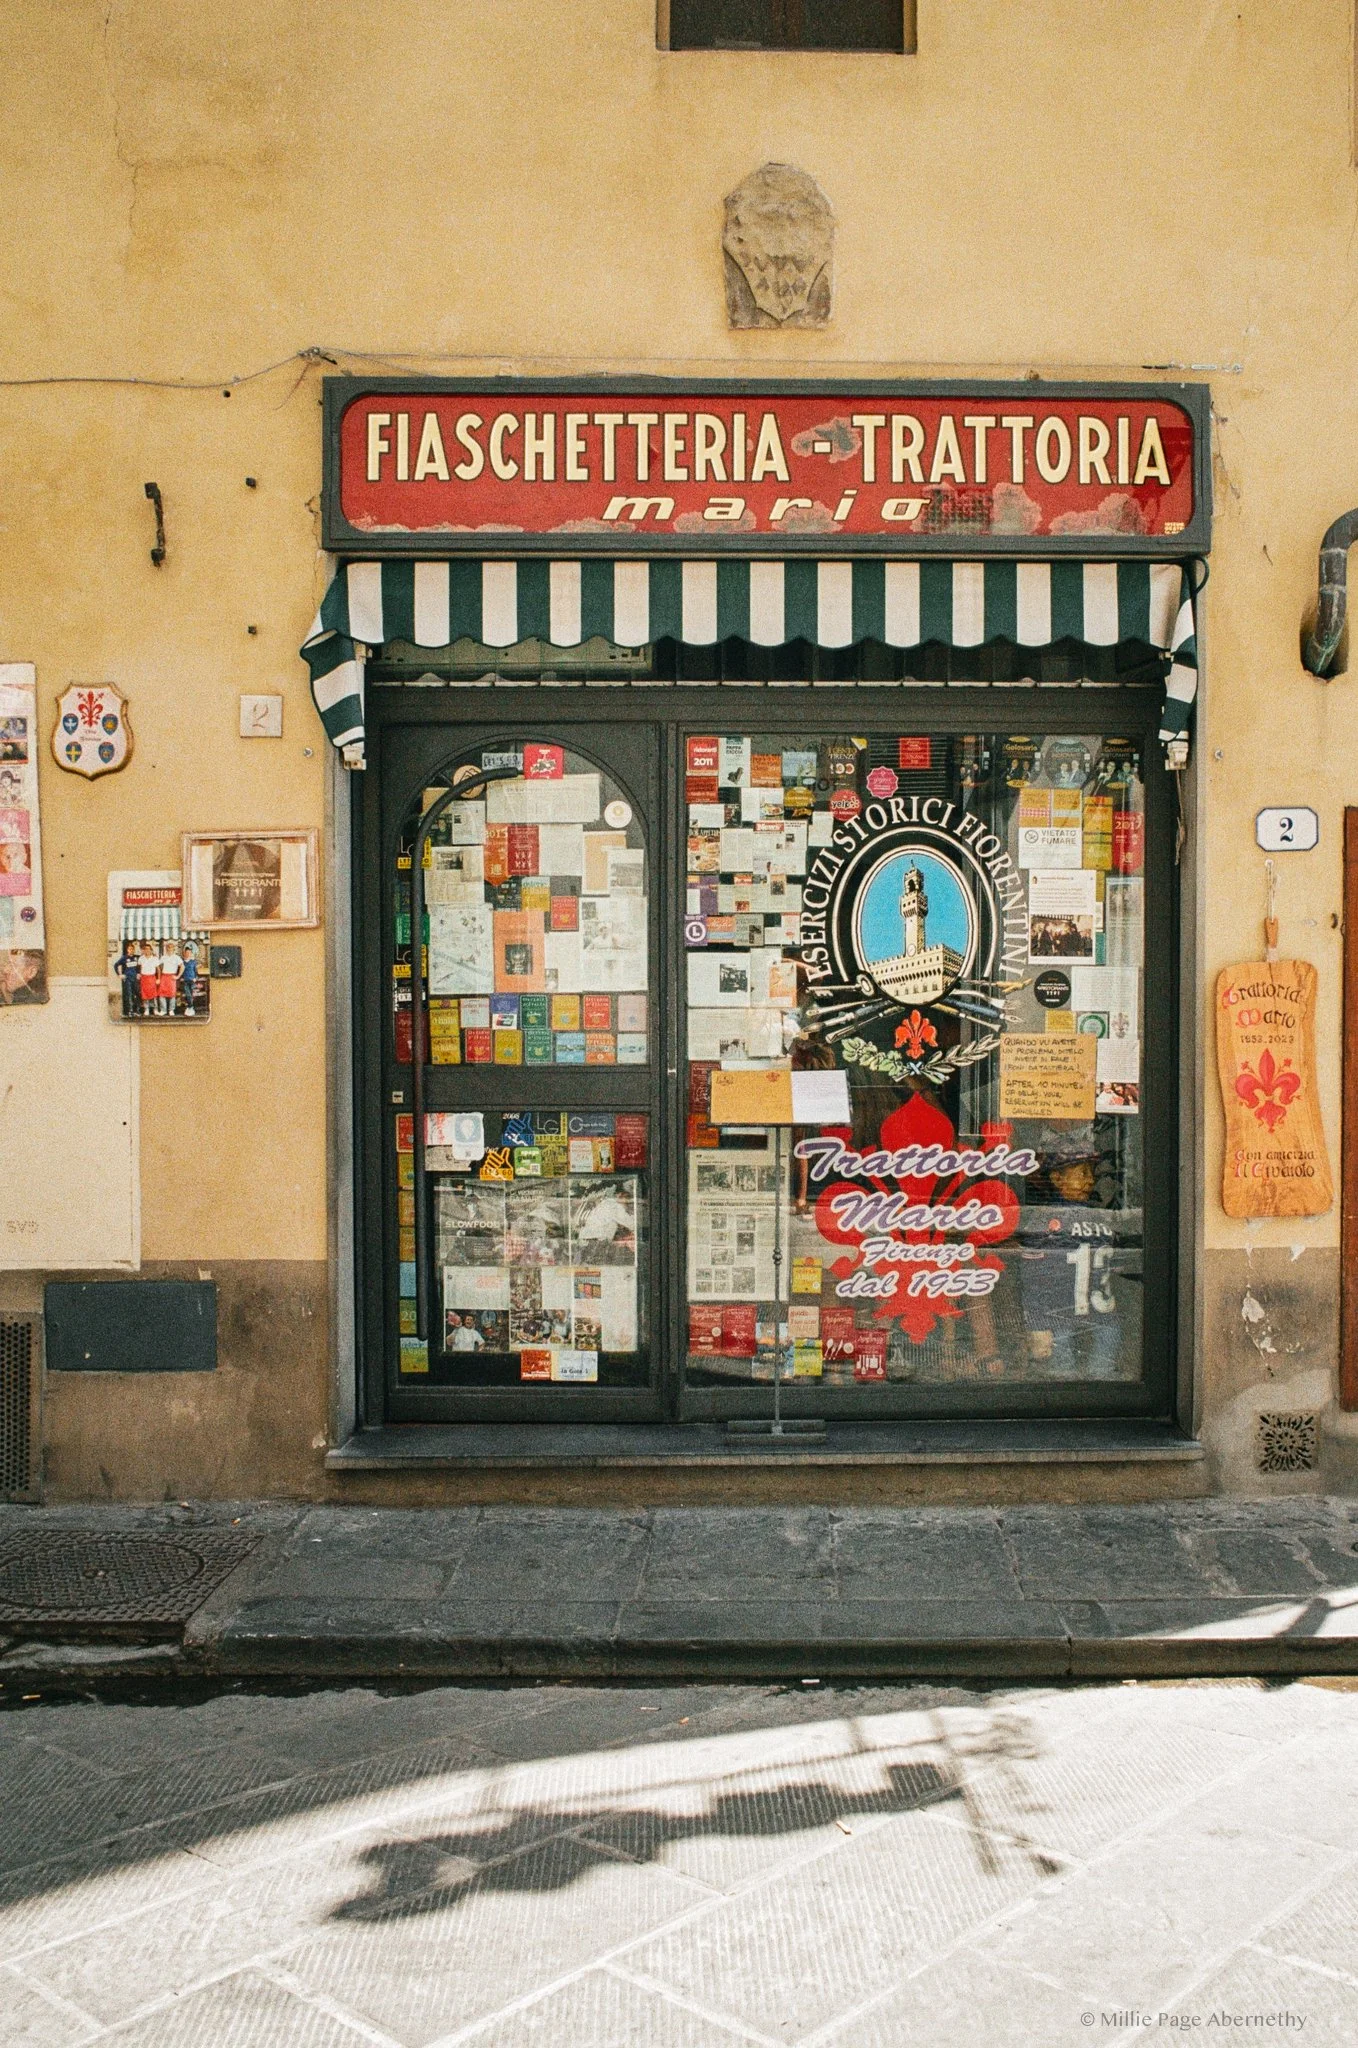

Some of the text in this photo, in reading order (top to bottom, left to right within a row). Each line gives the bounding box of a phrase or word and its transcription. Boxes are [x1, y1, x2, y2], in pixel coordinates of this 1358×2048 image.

[366, 413, 790, 482] FIASCHETTERIA
[852, 415, 1171, 485] TRATTORIA
[602, 490, 931, 521] mario
[252, 702, 269, 729] 2
[693, 758, 714, 766] 2011
[831, 801, 851, 809] yelp
[1279, 816, 1294, 843] 2
[126, 890, 176, 900] FIASCHETTERIA
[800, 848, 845, 982] ESERCIZI
[832, 795, 956, 853] STORICI
[953, 811, 1029, 977] FIORENTINI
[1222, 983, 1302, 1009] Trattoria
[1235, 1008, 1295, 1029] Mario
[1003, 1038, 1037, 1047] QUANDO
[795, 1138, 1038, 1179] Trattoria
[832, 1192, 1002, 1231] Mario
[862, 1237, 974, 1265] Firenze
[837, 1271, 898, 1297] dal
[908, 1271, 998, 1298] 1953
